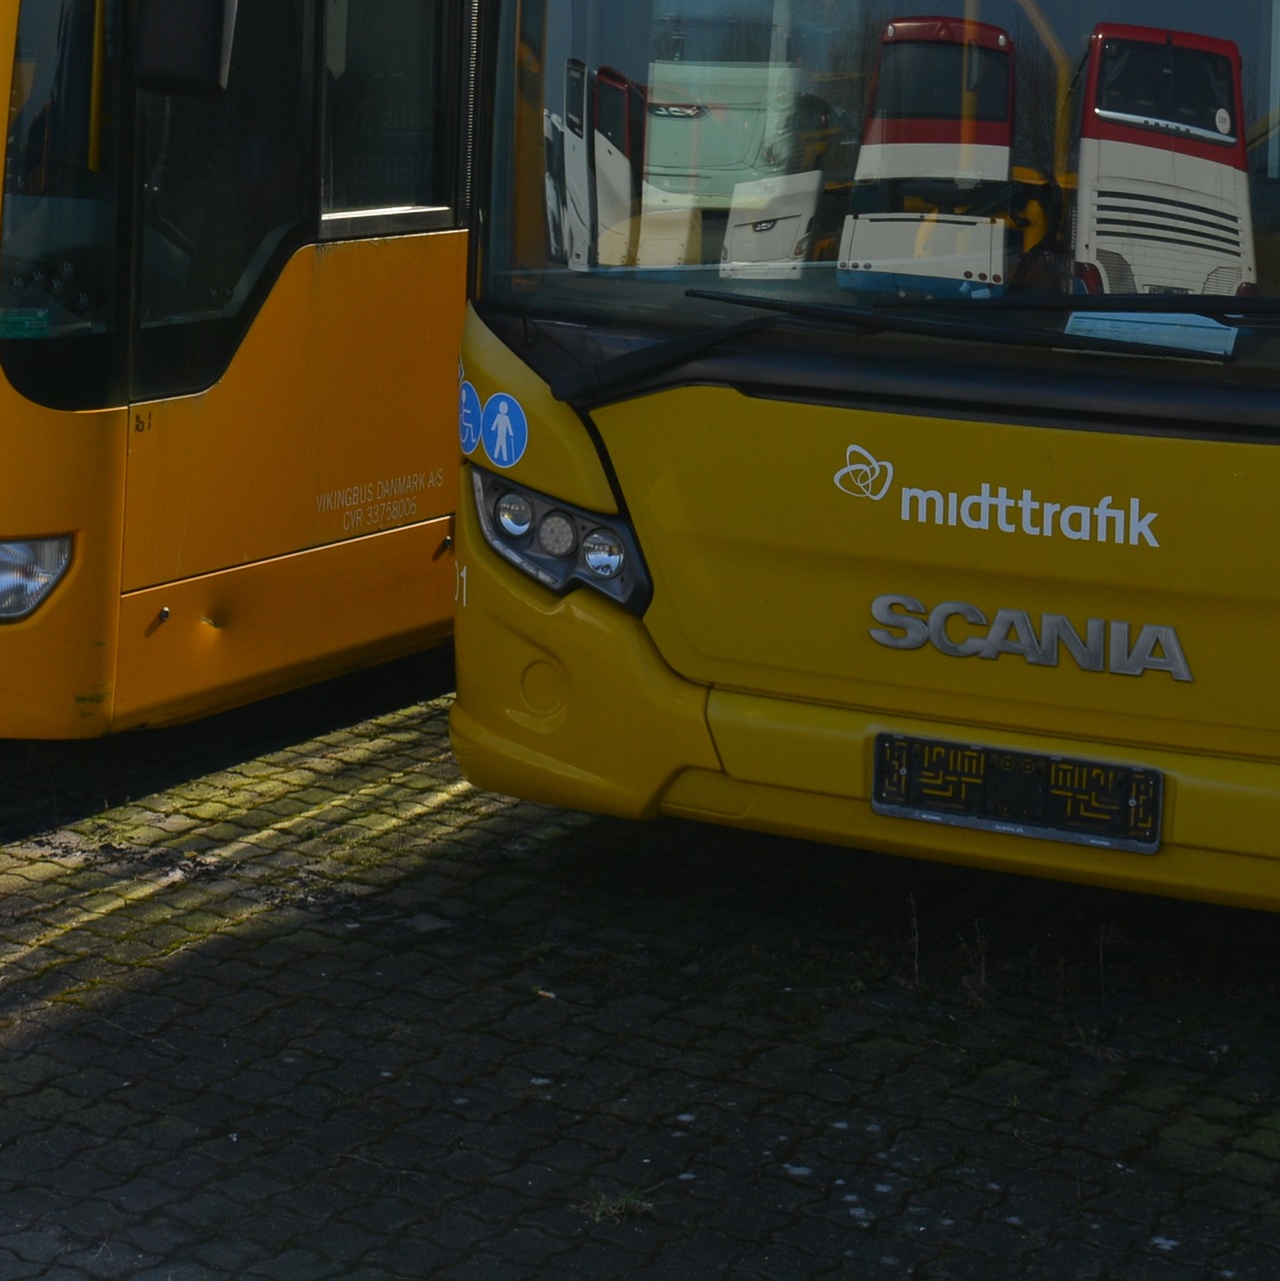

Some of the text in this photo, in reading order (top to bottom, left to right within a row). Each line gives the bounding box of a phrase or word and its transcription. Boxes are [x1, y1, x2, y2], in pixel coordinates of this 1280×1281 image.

[316, 468, 444, 512] VIKINGBUS DANMARK A/S
[343, 496, 418, 531] CVR 33758006
[900, 483, 1160, 547] midttrafik
[867, 592, 1195, 683] SCANIA
